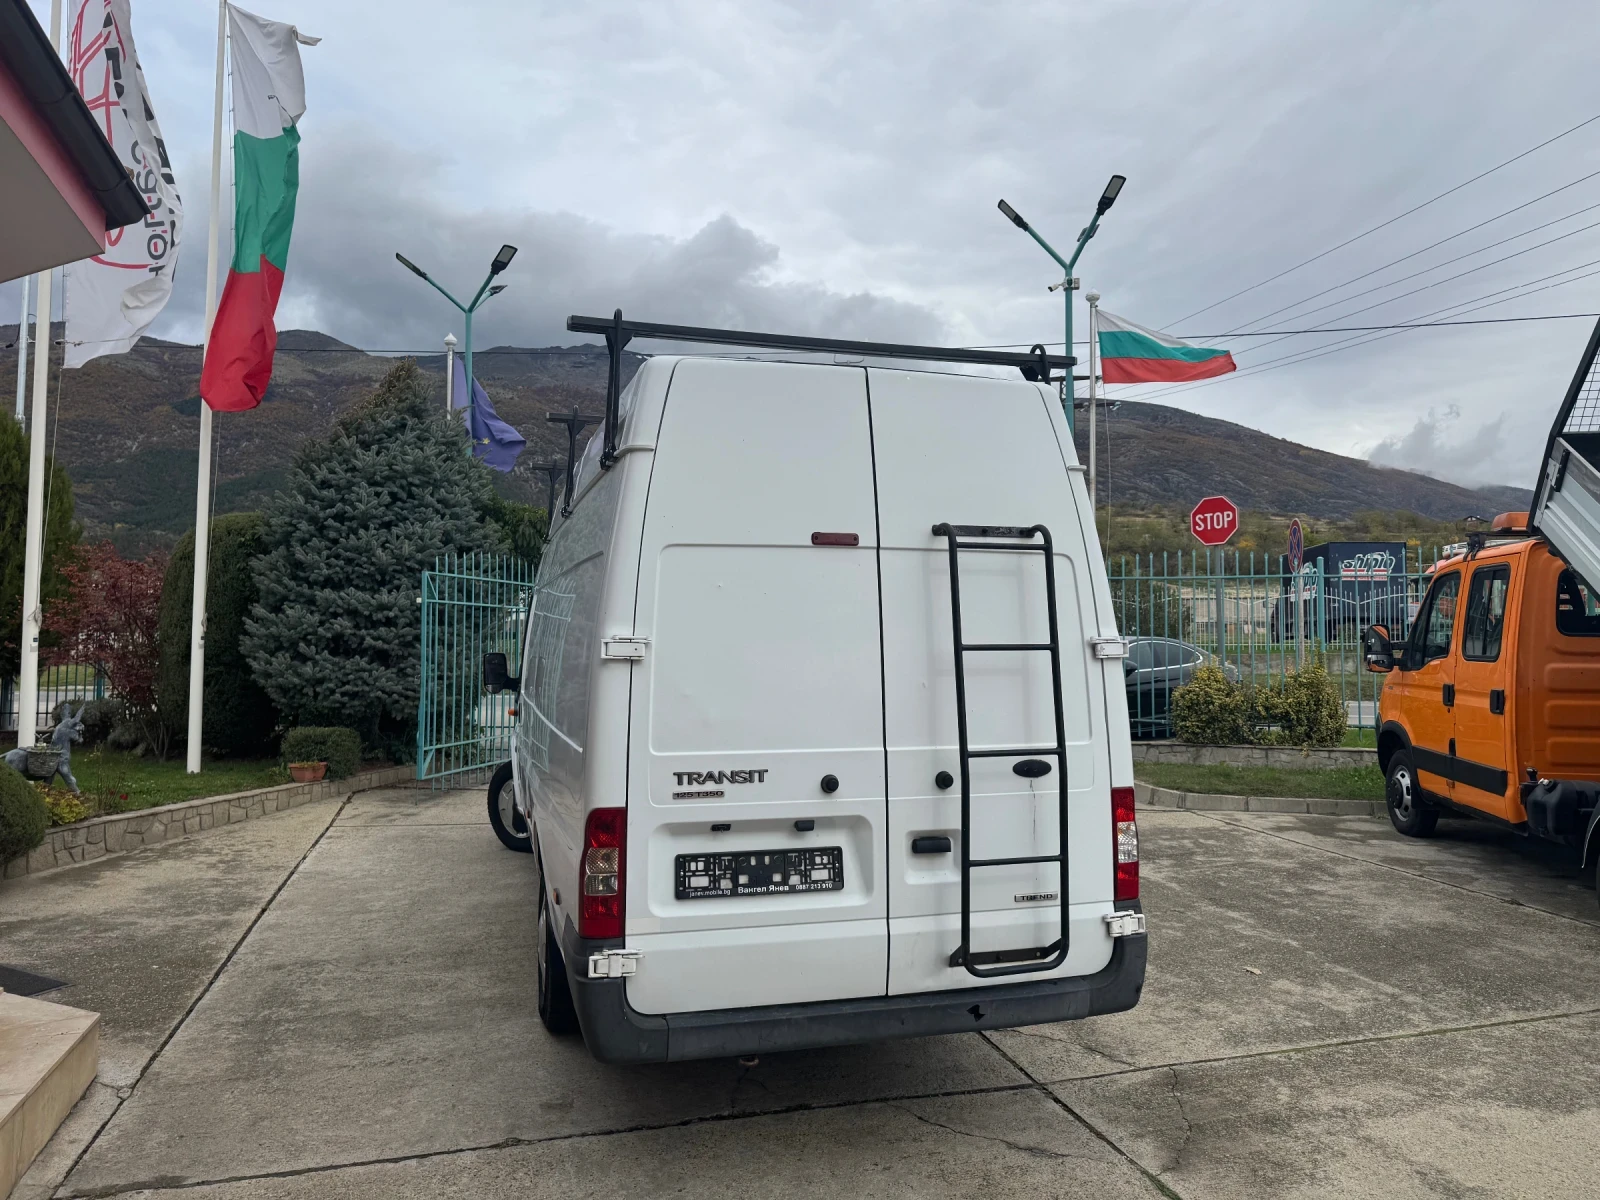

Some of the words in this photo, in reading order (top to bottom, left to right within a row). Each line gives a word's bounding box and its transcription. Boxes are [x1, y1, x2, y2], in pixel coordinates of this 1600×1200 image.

[1195, 511, 1233, 531] STOP
[673, 769, 768, 785] TRANSIT
[738, 886, 767, 894] Вангел
[769, 884, 789, 892] Янев
[1020, 893, 1053, 901] TREND
